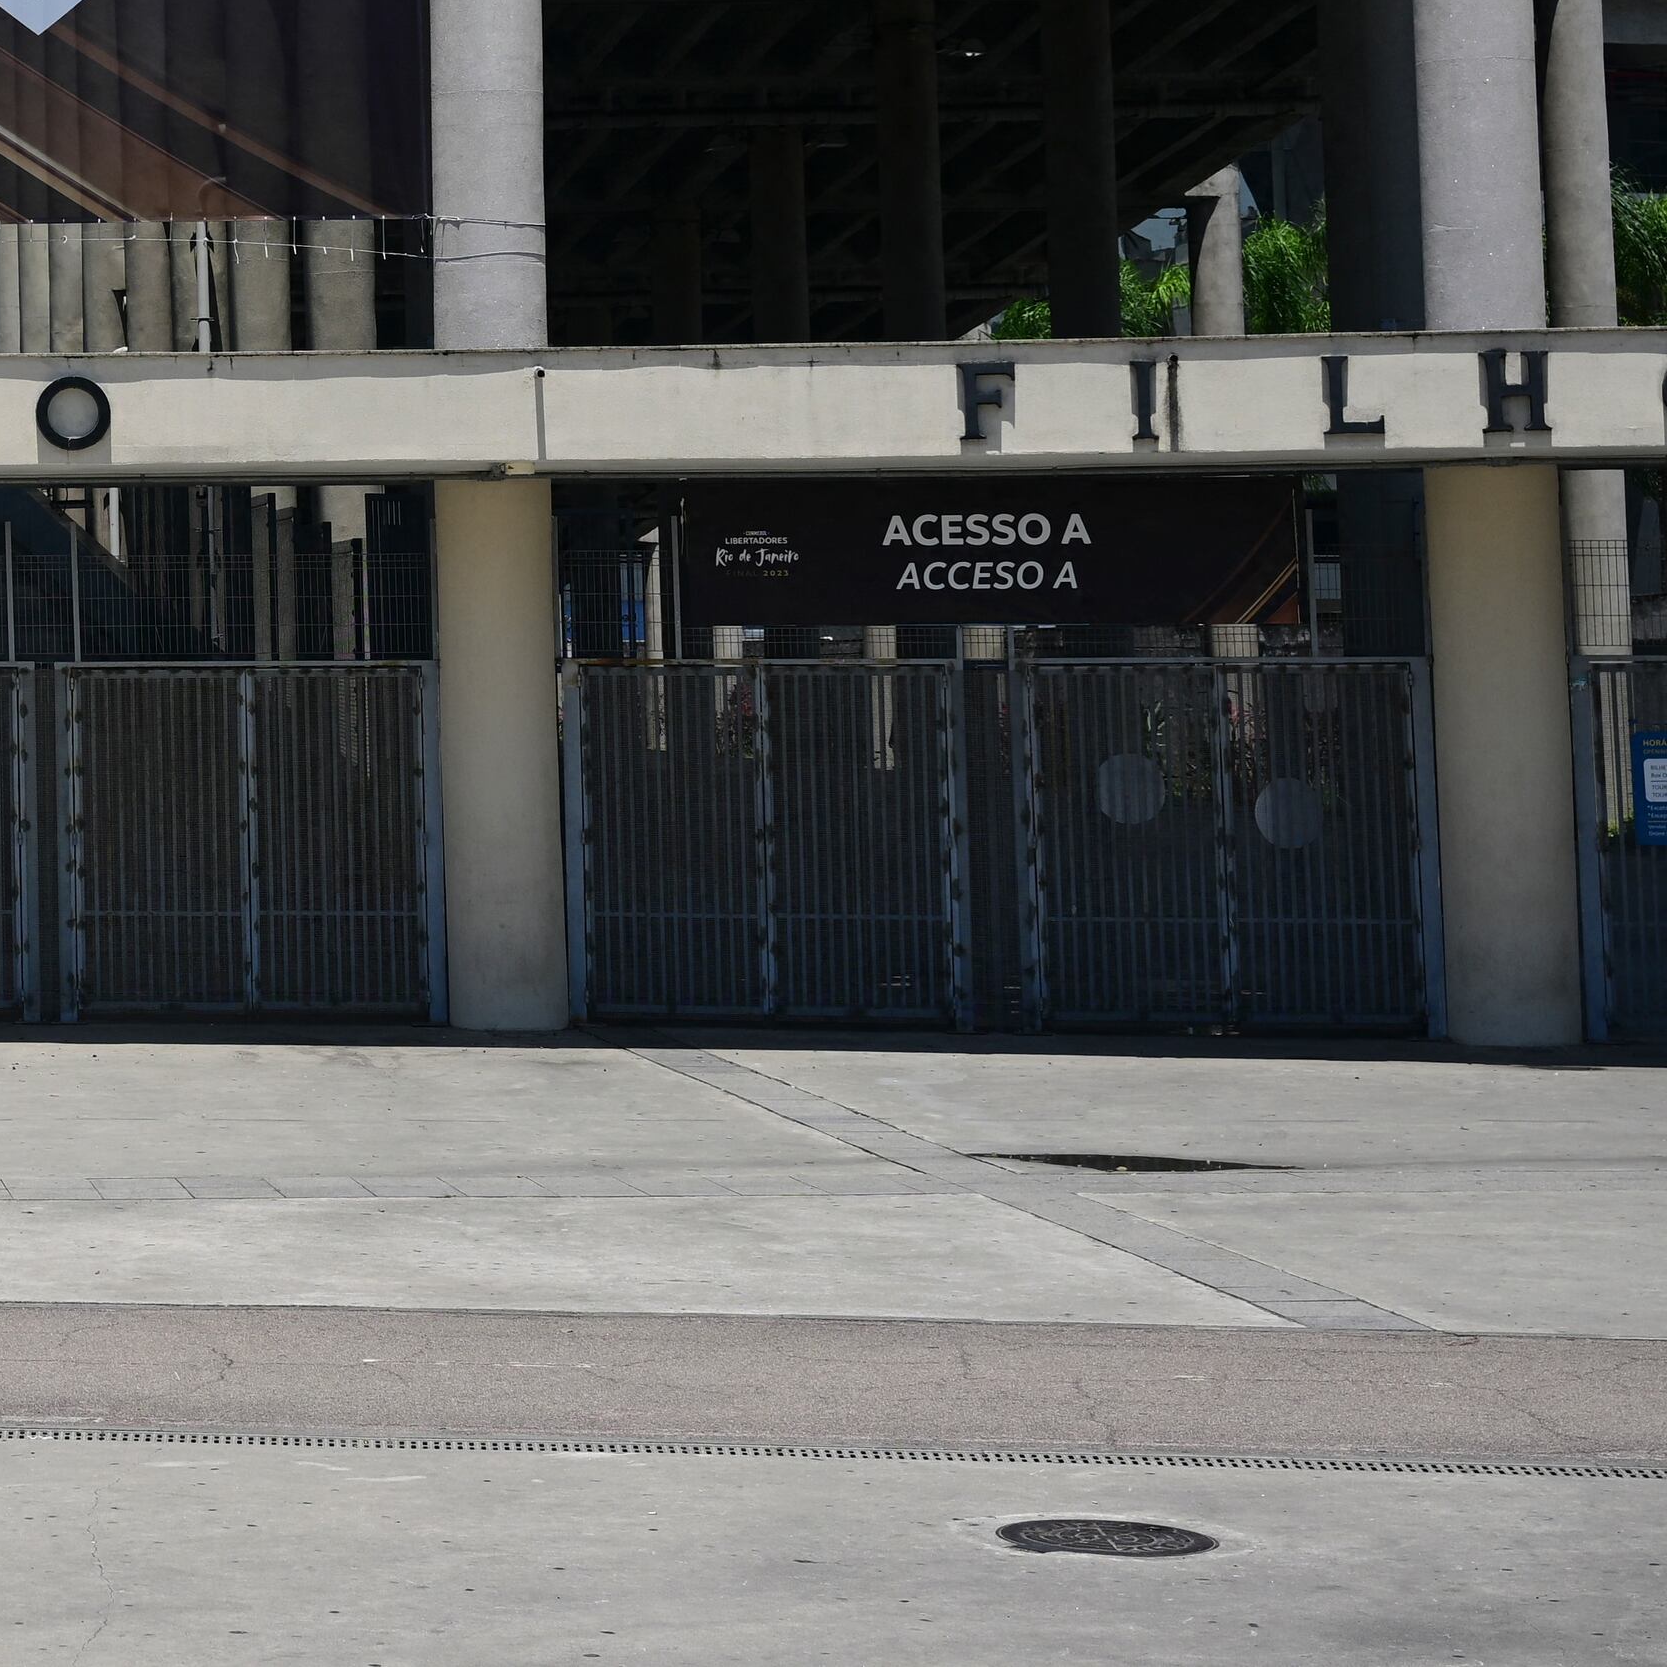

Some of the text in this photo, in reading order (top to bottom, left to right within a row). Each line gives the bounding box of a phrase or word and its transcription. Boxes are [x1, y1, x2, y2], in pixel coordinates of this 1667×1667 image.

[955, 347, 1667, 442] FILH
[725, 536, 788, 545] LIBERTADORES
[881, 513, 1093, 547] ACESSO A
[715, 547, 800, 567] Rio de Janeiro
[762, 569, 789, 577] 2023
[895, 561, 1079, 591] ACCESO A
